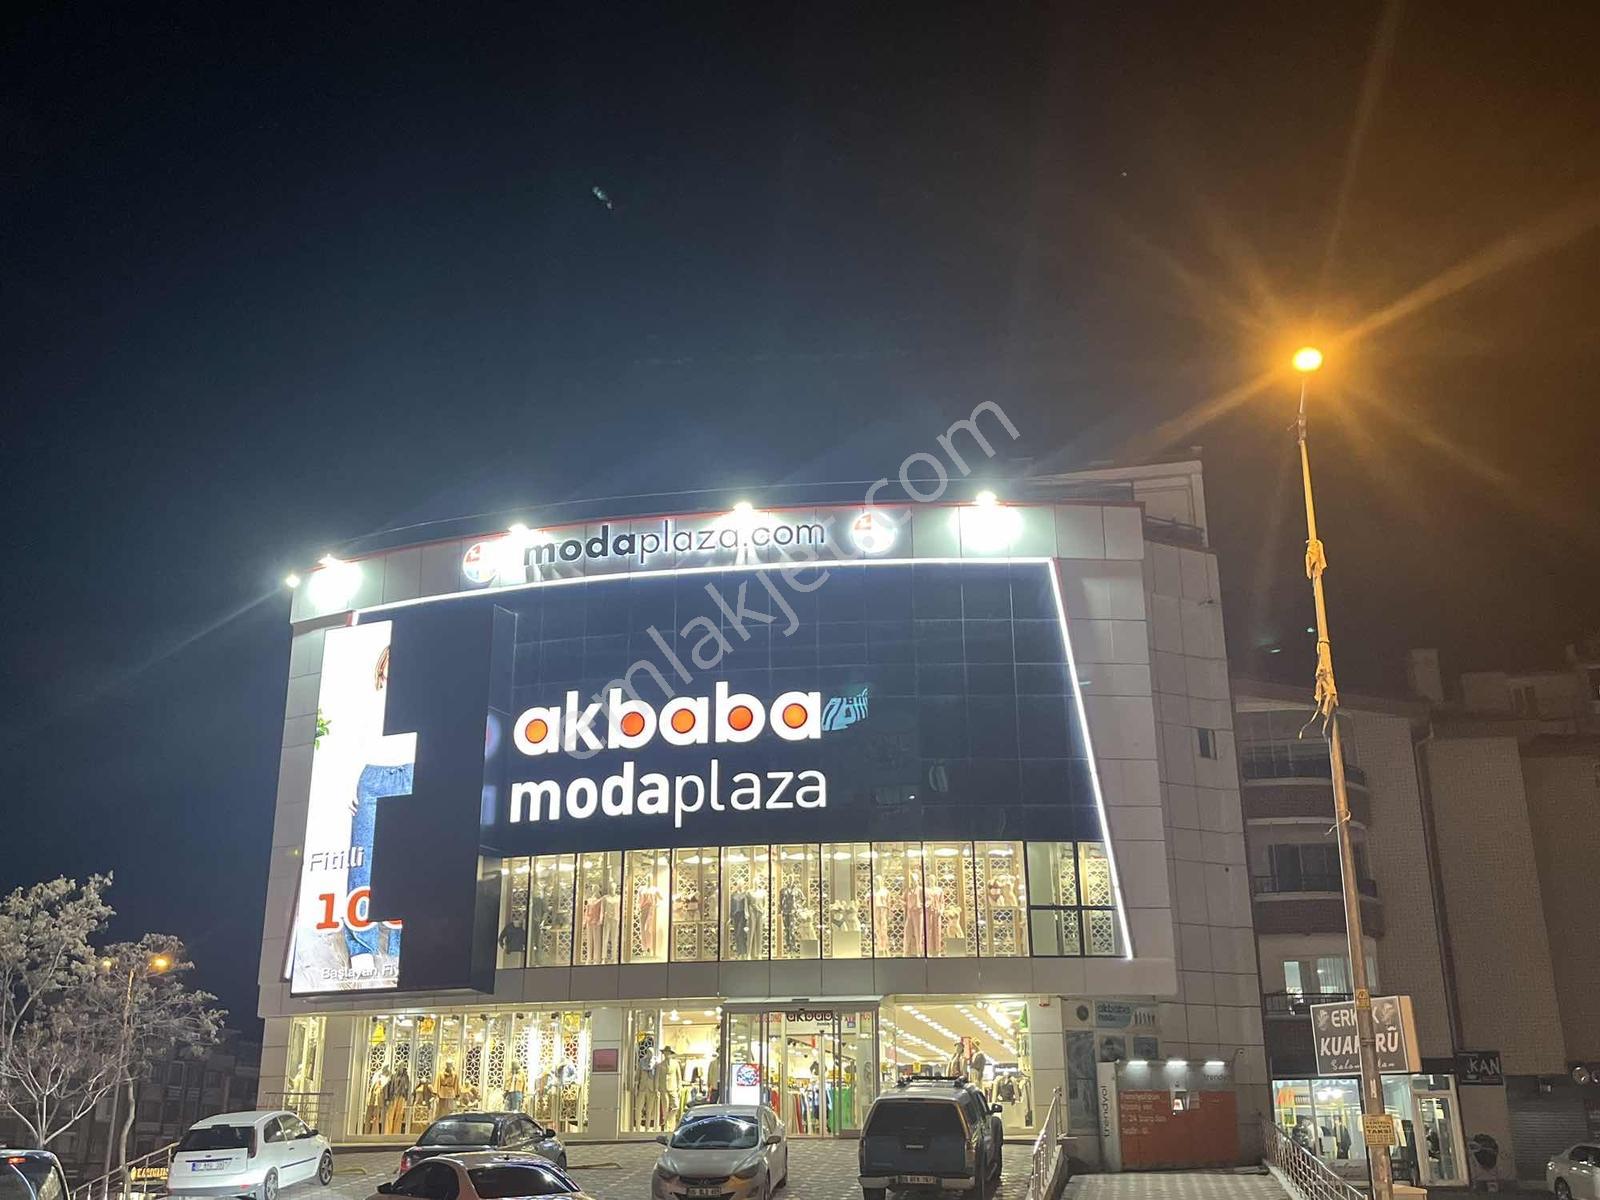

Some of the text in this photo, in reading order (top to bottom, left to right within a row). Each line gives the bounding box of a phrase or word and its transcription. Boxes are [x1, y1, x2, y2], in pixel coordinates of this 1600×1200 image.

[522, 518, 826, 566] modaplaza.com
[513, 681, 822, 756] akbaba
[509, 759, 827, 828] modaplaza
[316, 887, 404, 931] 10
[1331, 1006, 1380, 1028] ERKK
[1320, 1025, 1399, 1057] KUARÜ
